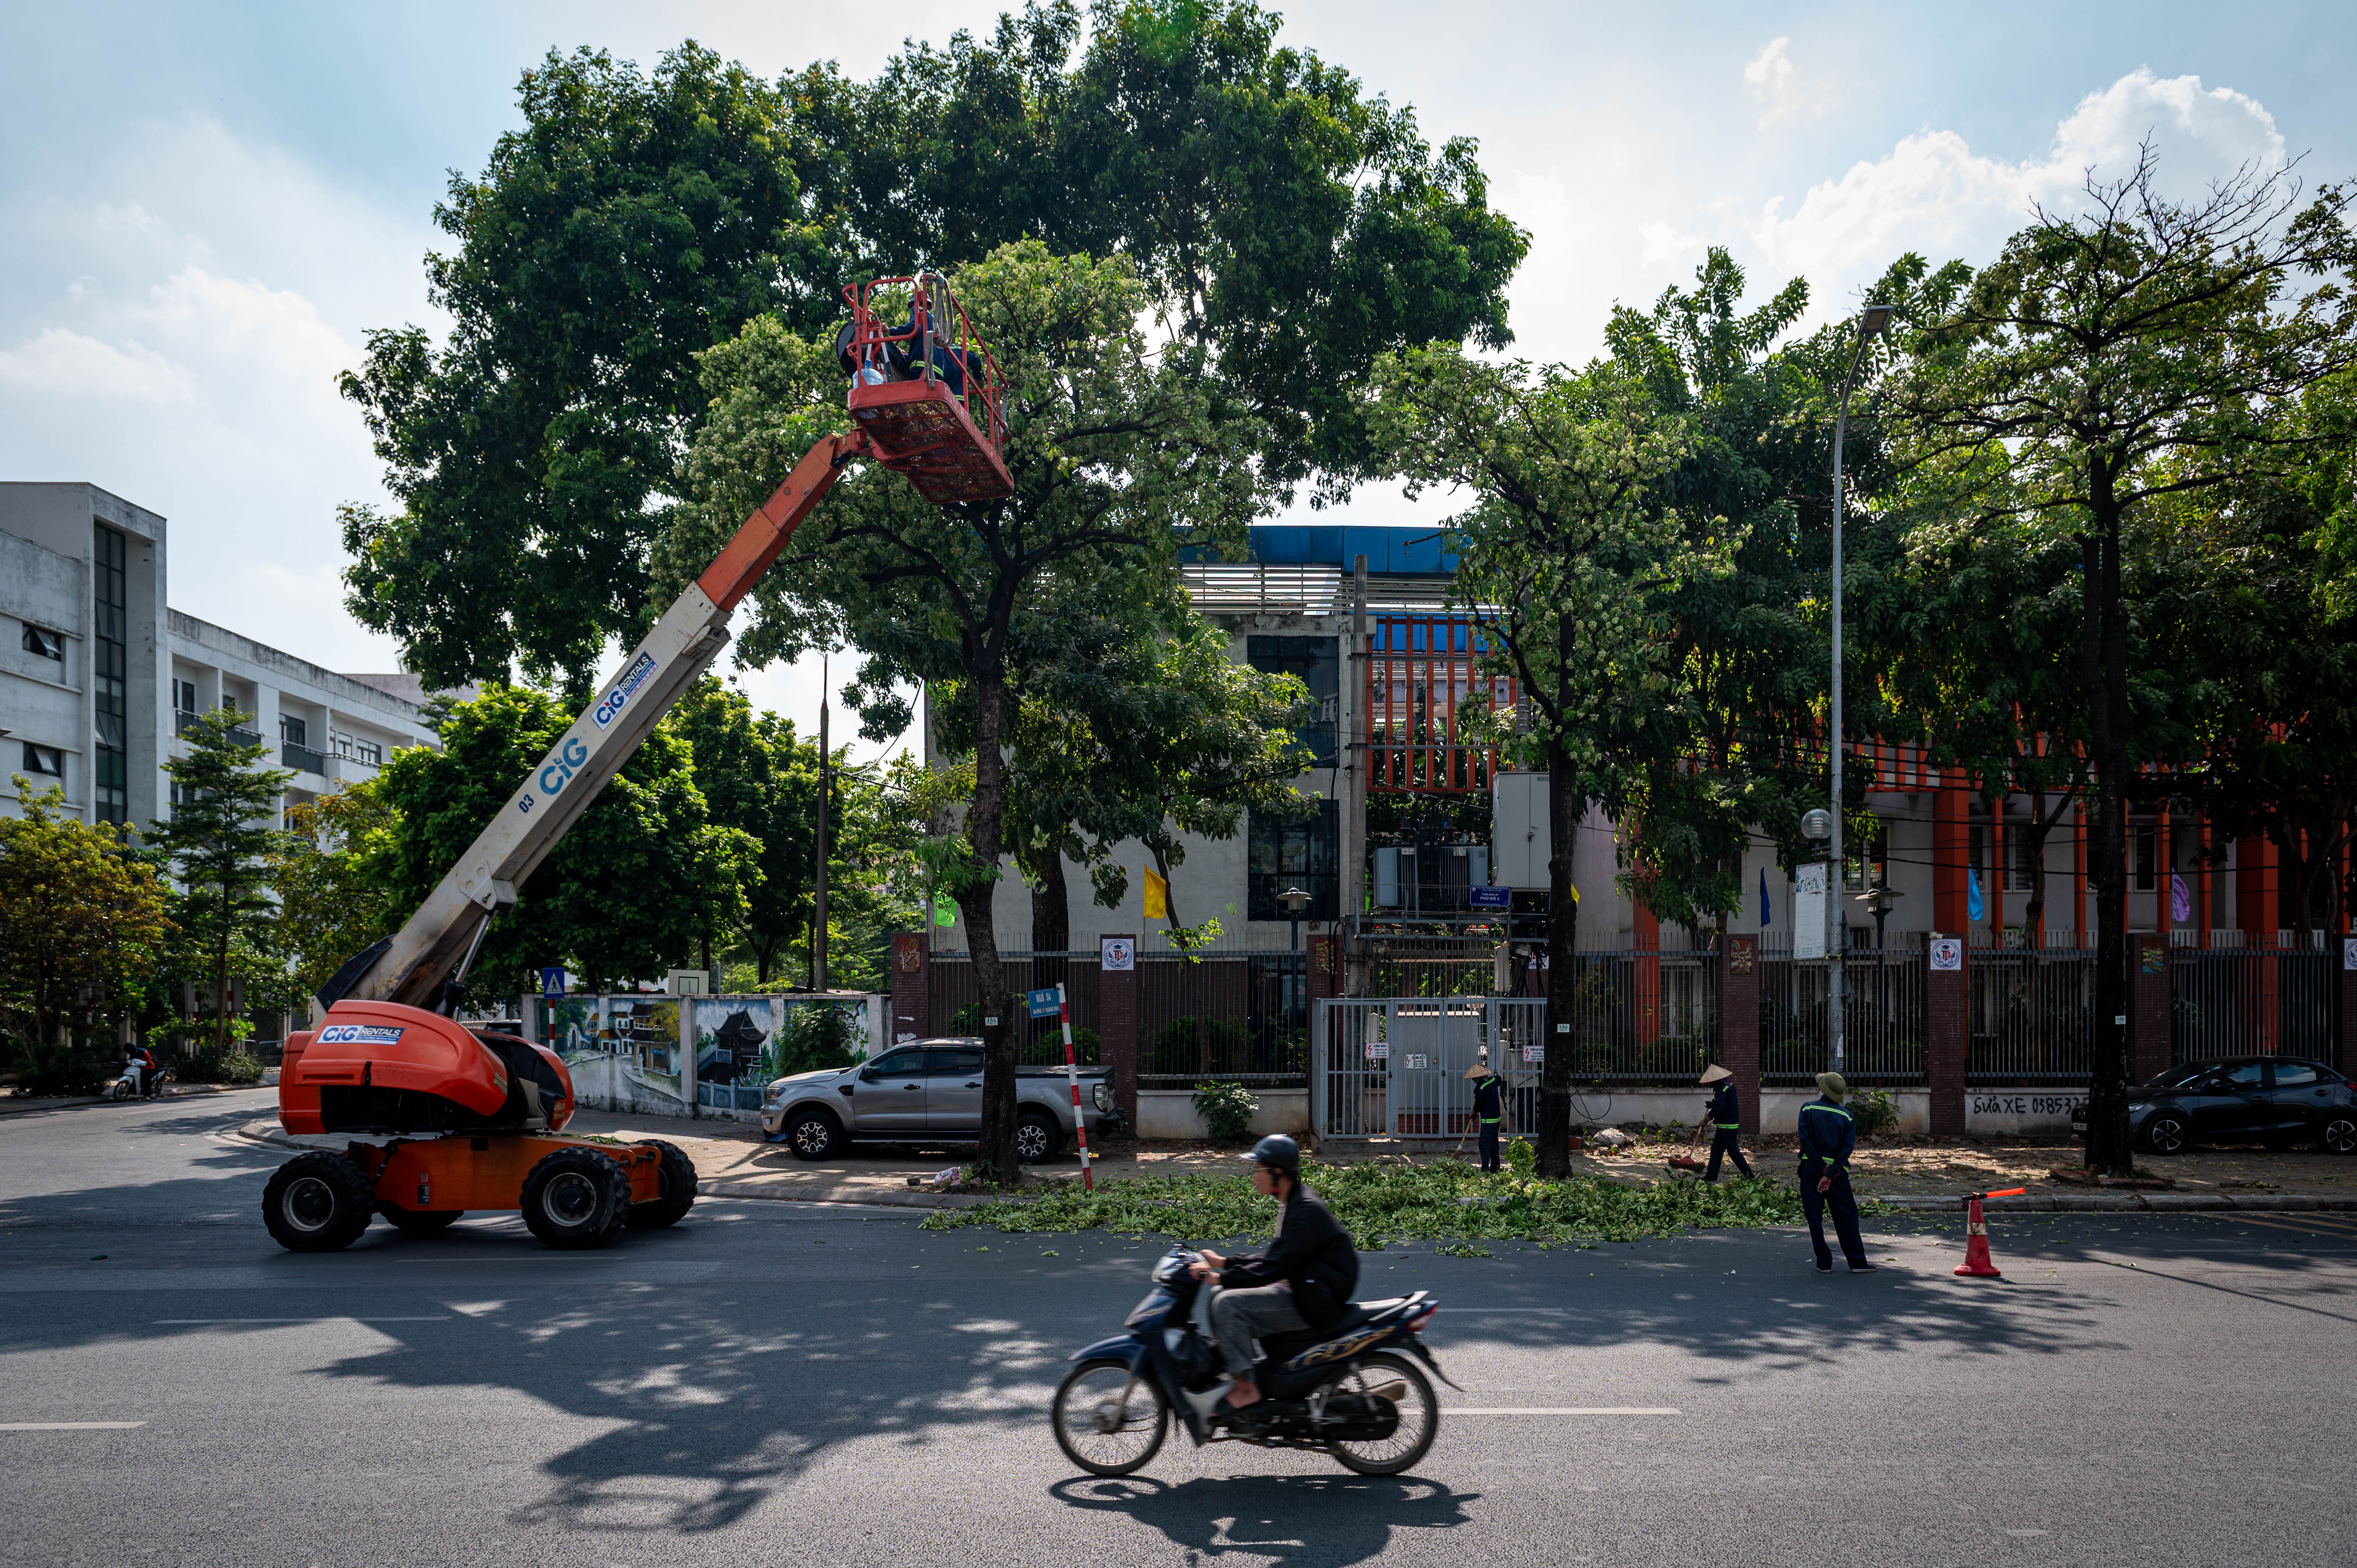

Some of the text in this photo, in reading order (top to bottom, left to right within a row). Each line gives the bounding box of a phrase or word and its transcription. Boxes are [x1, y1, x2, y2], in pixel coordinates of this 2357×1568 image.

[620, 657, 649, 691] RENTALS
[519, 794, 534, 813] 03
[1036, 992, 1051, 1002] NGÕ 54
[360, 1028, 401, 1036] RENTALS
[2004, 1097, 2026, 1114] XE
